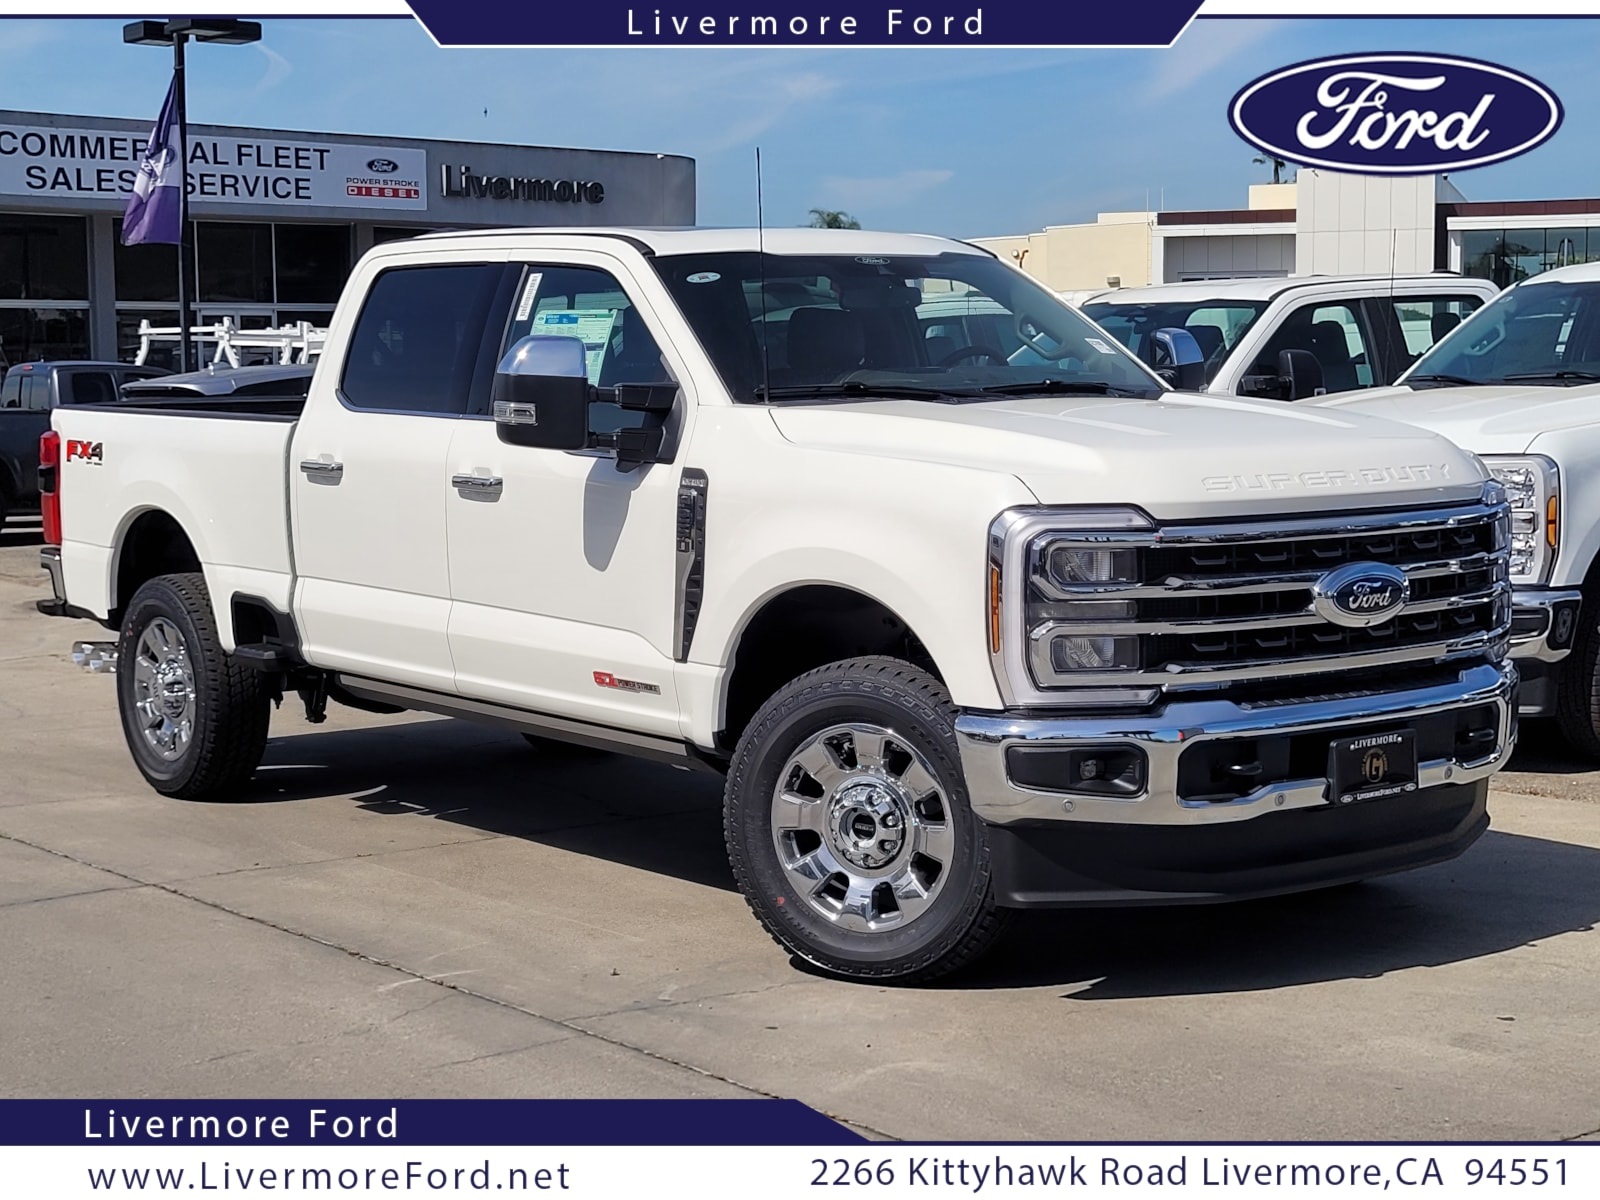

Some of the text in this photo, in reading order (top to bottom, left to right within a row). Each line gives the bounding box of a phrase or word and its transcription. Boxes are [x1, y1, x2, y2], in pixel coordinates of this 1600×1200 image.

[0, 131, 229, 165] COMMERAL
[237, 144, 331, 170] FLEET
[26, 165, 136, 192] SALES
[186, 172, 312, 200] SERVICE
[346, 177, 420, 188] POWER STROKE
[347, 187, 419, 198] DIESEL
[440, 164, 605, 204] Livermore
[66, 439, 104, 462] FX4
[1201, 463, 1451, 492] SUPER DUTY
[1348, 581, 1393, 610] Ford
[1354, 734, 1399, 749] LIVERMORE
